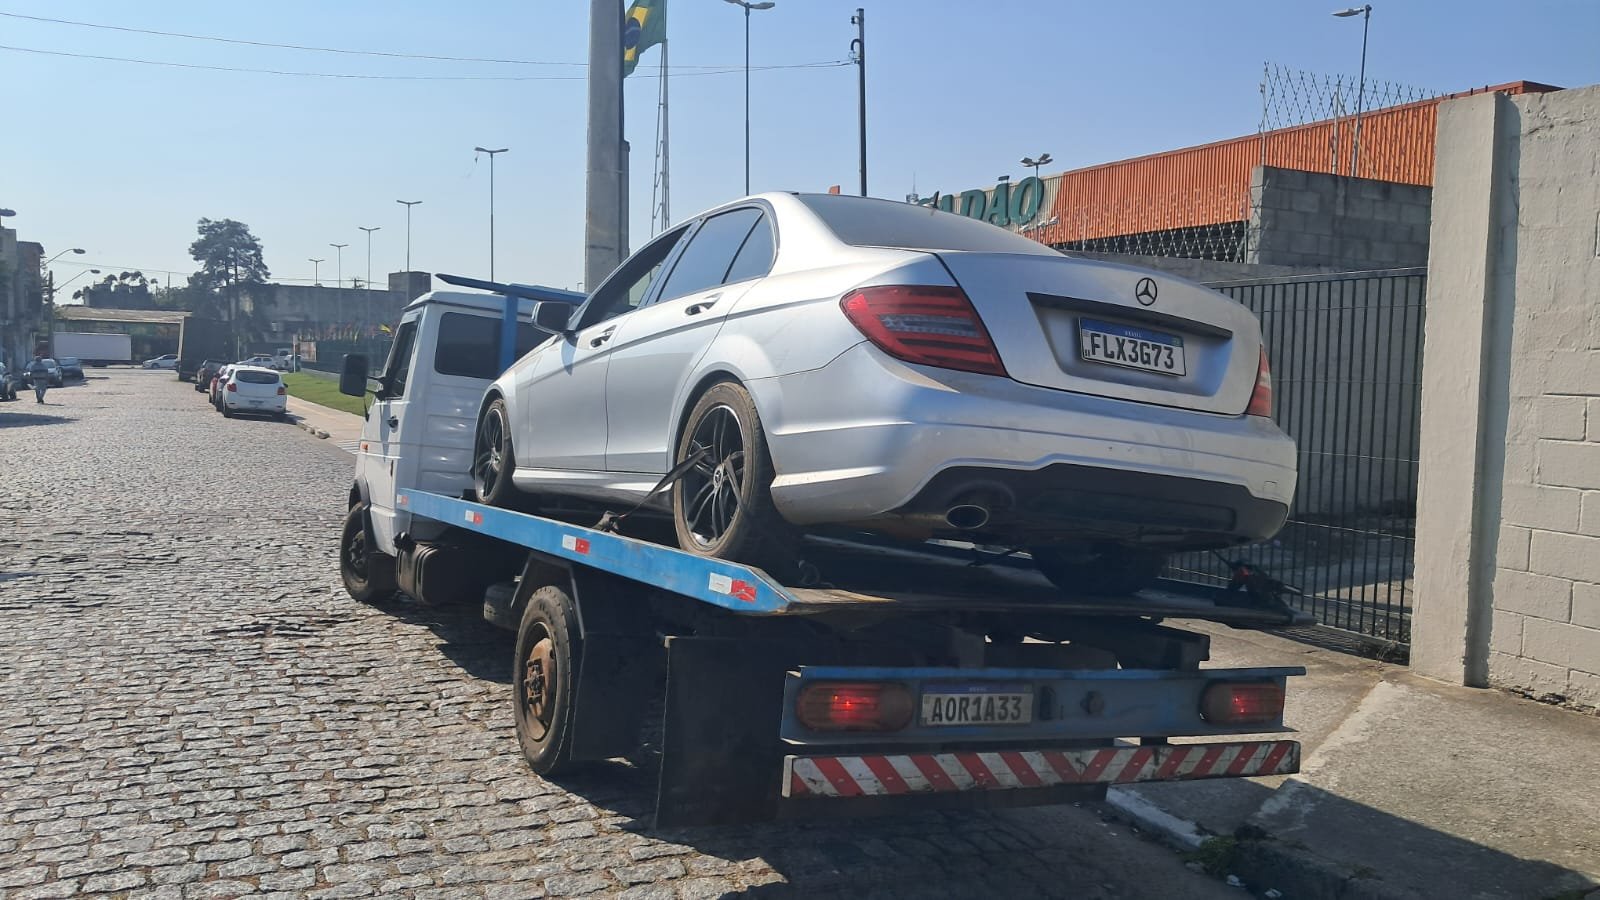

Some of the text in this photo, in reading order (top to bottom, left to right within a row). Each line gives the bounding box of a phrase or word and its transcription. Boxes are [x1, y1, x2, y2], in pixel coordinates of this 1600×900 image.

[919, 175, 1045, 227] DÃO
[1090, 332, 1174, 370] FLX3G73
[931, 695, 1022, 722] AOR1A33
